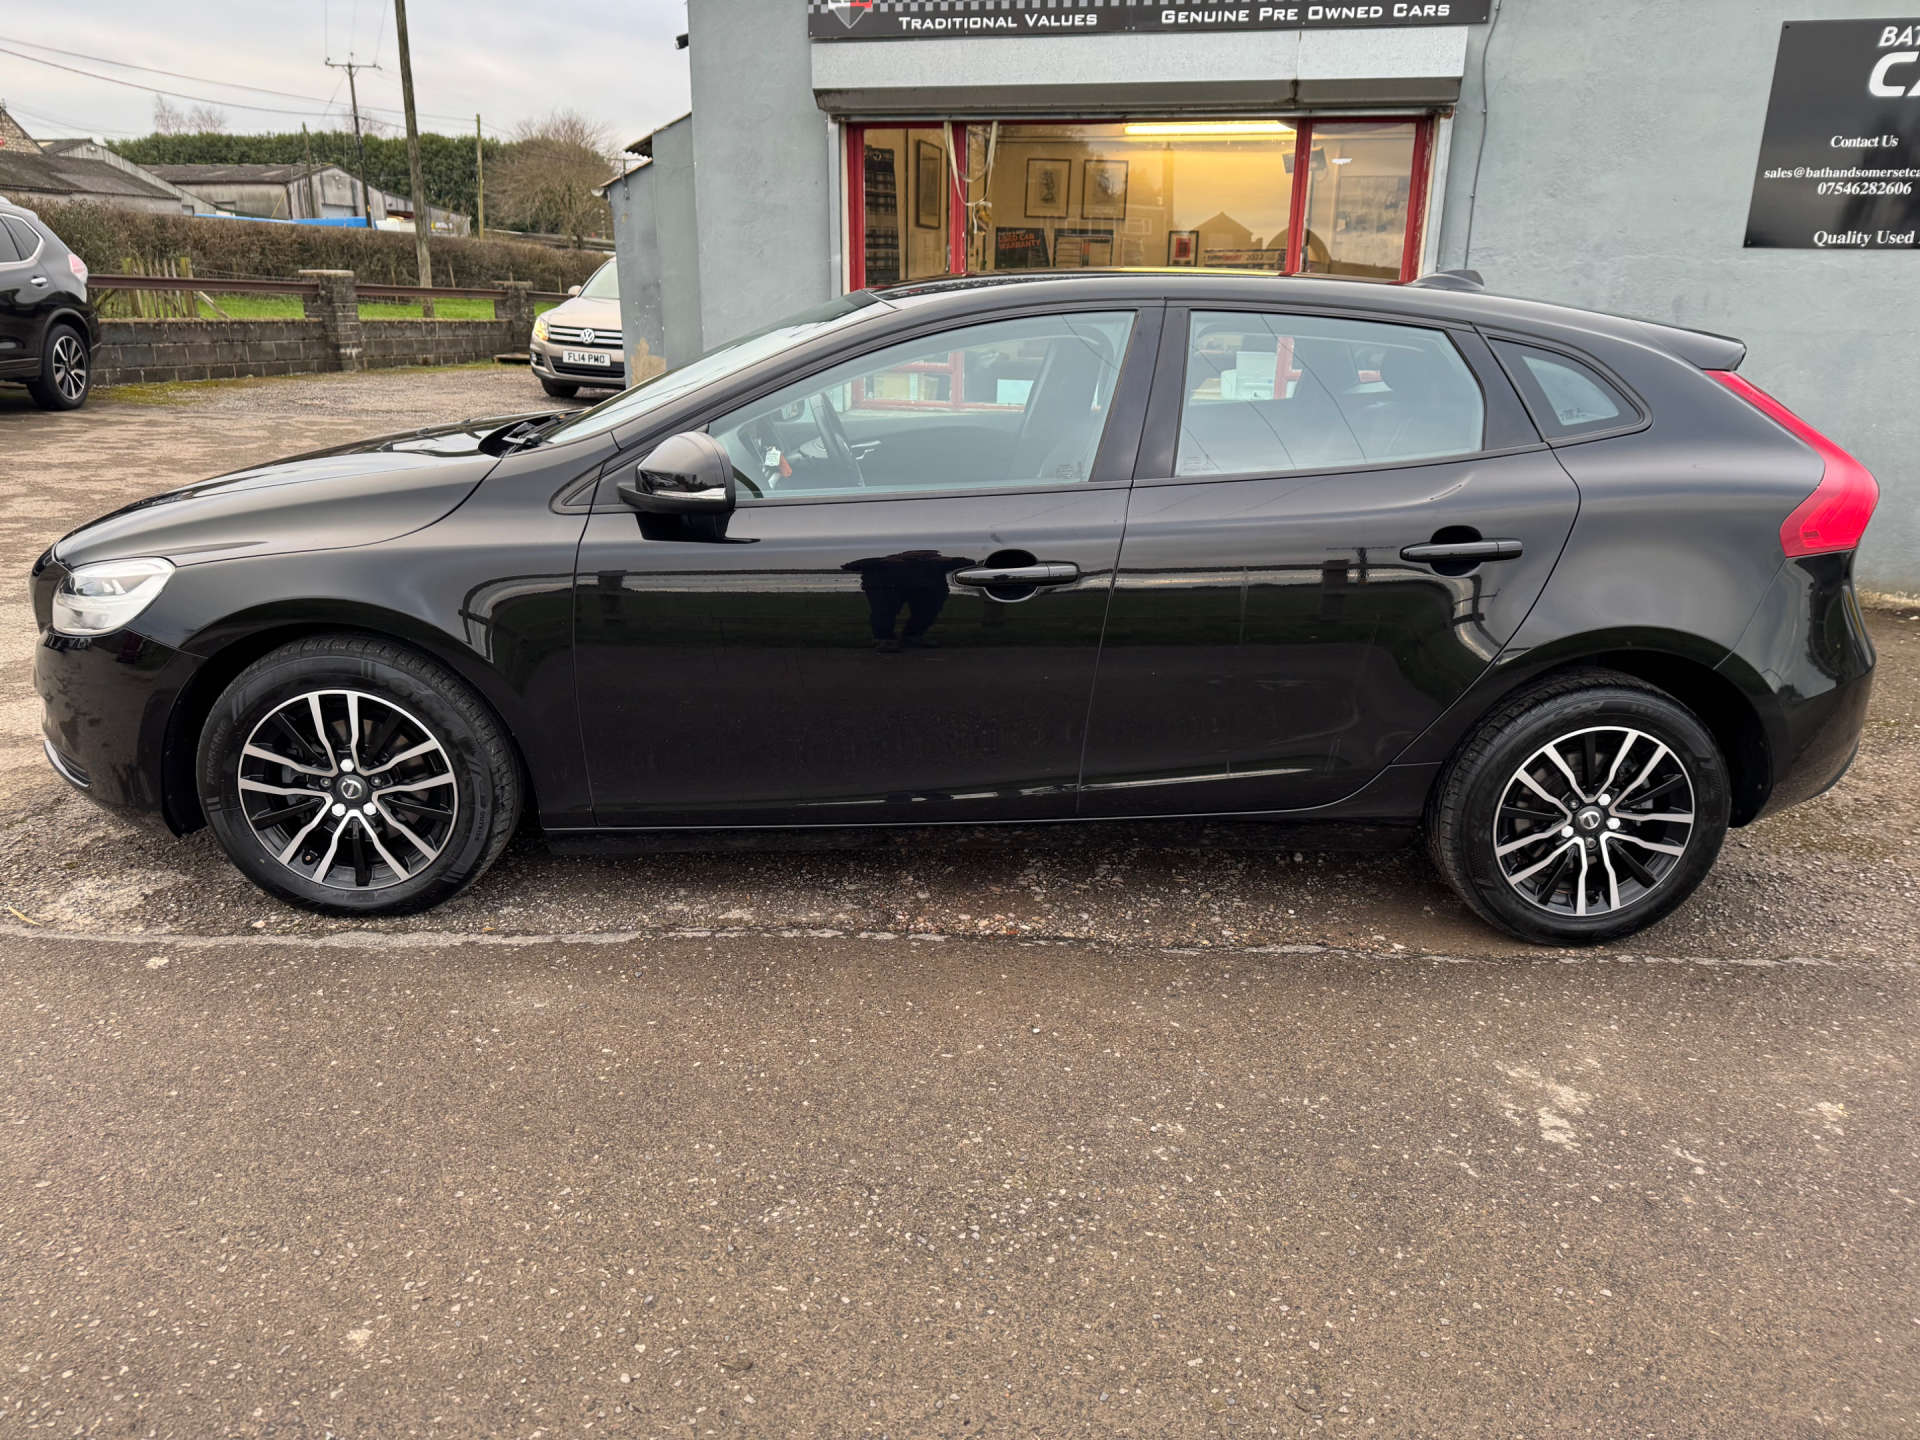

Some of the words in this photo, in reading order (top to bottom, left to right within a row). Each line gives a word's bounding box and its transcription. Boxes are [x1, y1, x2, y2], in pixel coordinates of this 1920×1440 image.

[899, 16, 1017, 31] TRADITIONAL
[1025, 13, 1097, 27] VALUES
[1161, 9, 1250, 24] GENUINE
[1259, 7, 1298, 21] PRE
[1308, 6, 1383, 20] OWNED
[1393, 3, 1450, 17] CARS
[1868, 51, 1920, 97] C
[1830, 135, 1879, 148] Contact
[1881, 134, 1899, 147] Us
[1817, 182, 1912, 195] 07546282606
[1813, 231, 1872, 247] Quality
[1877, 230, 1915, 245] Used
[568, 352, 585, 362] FL14
